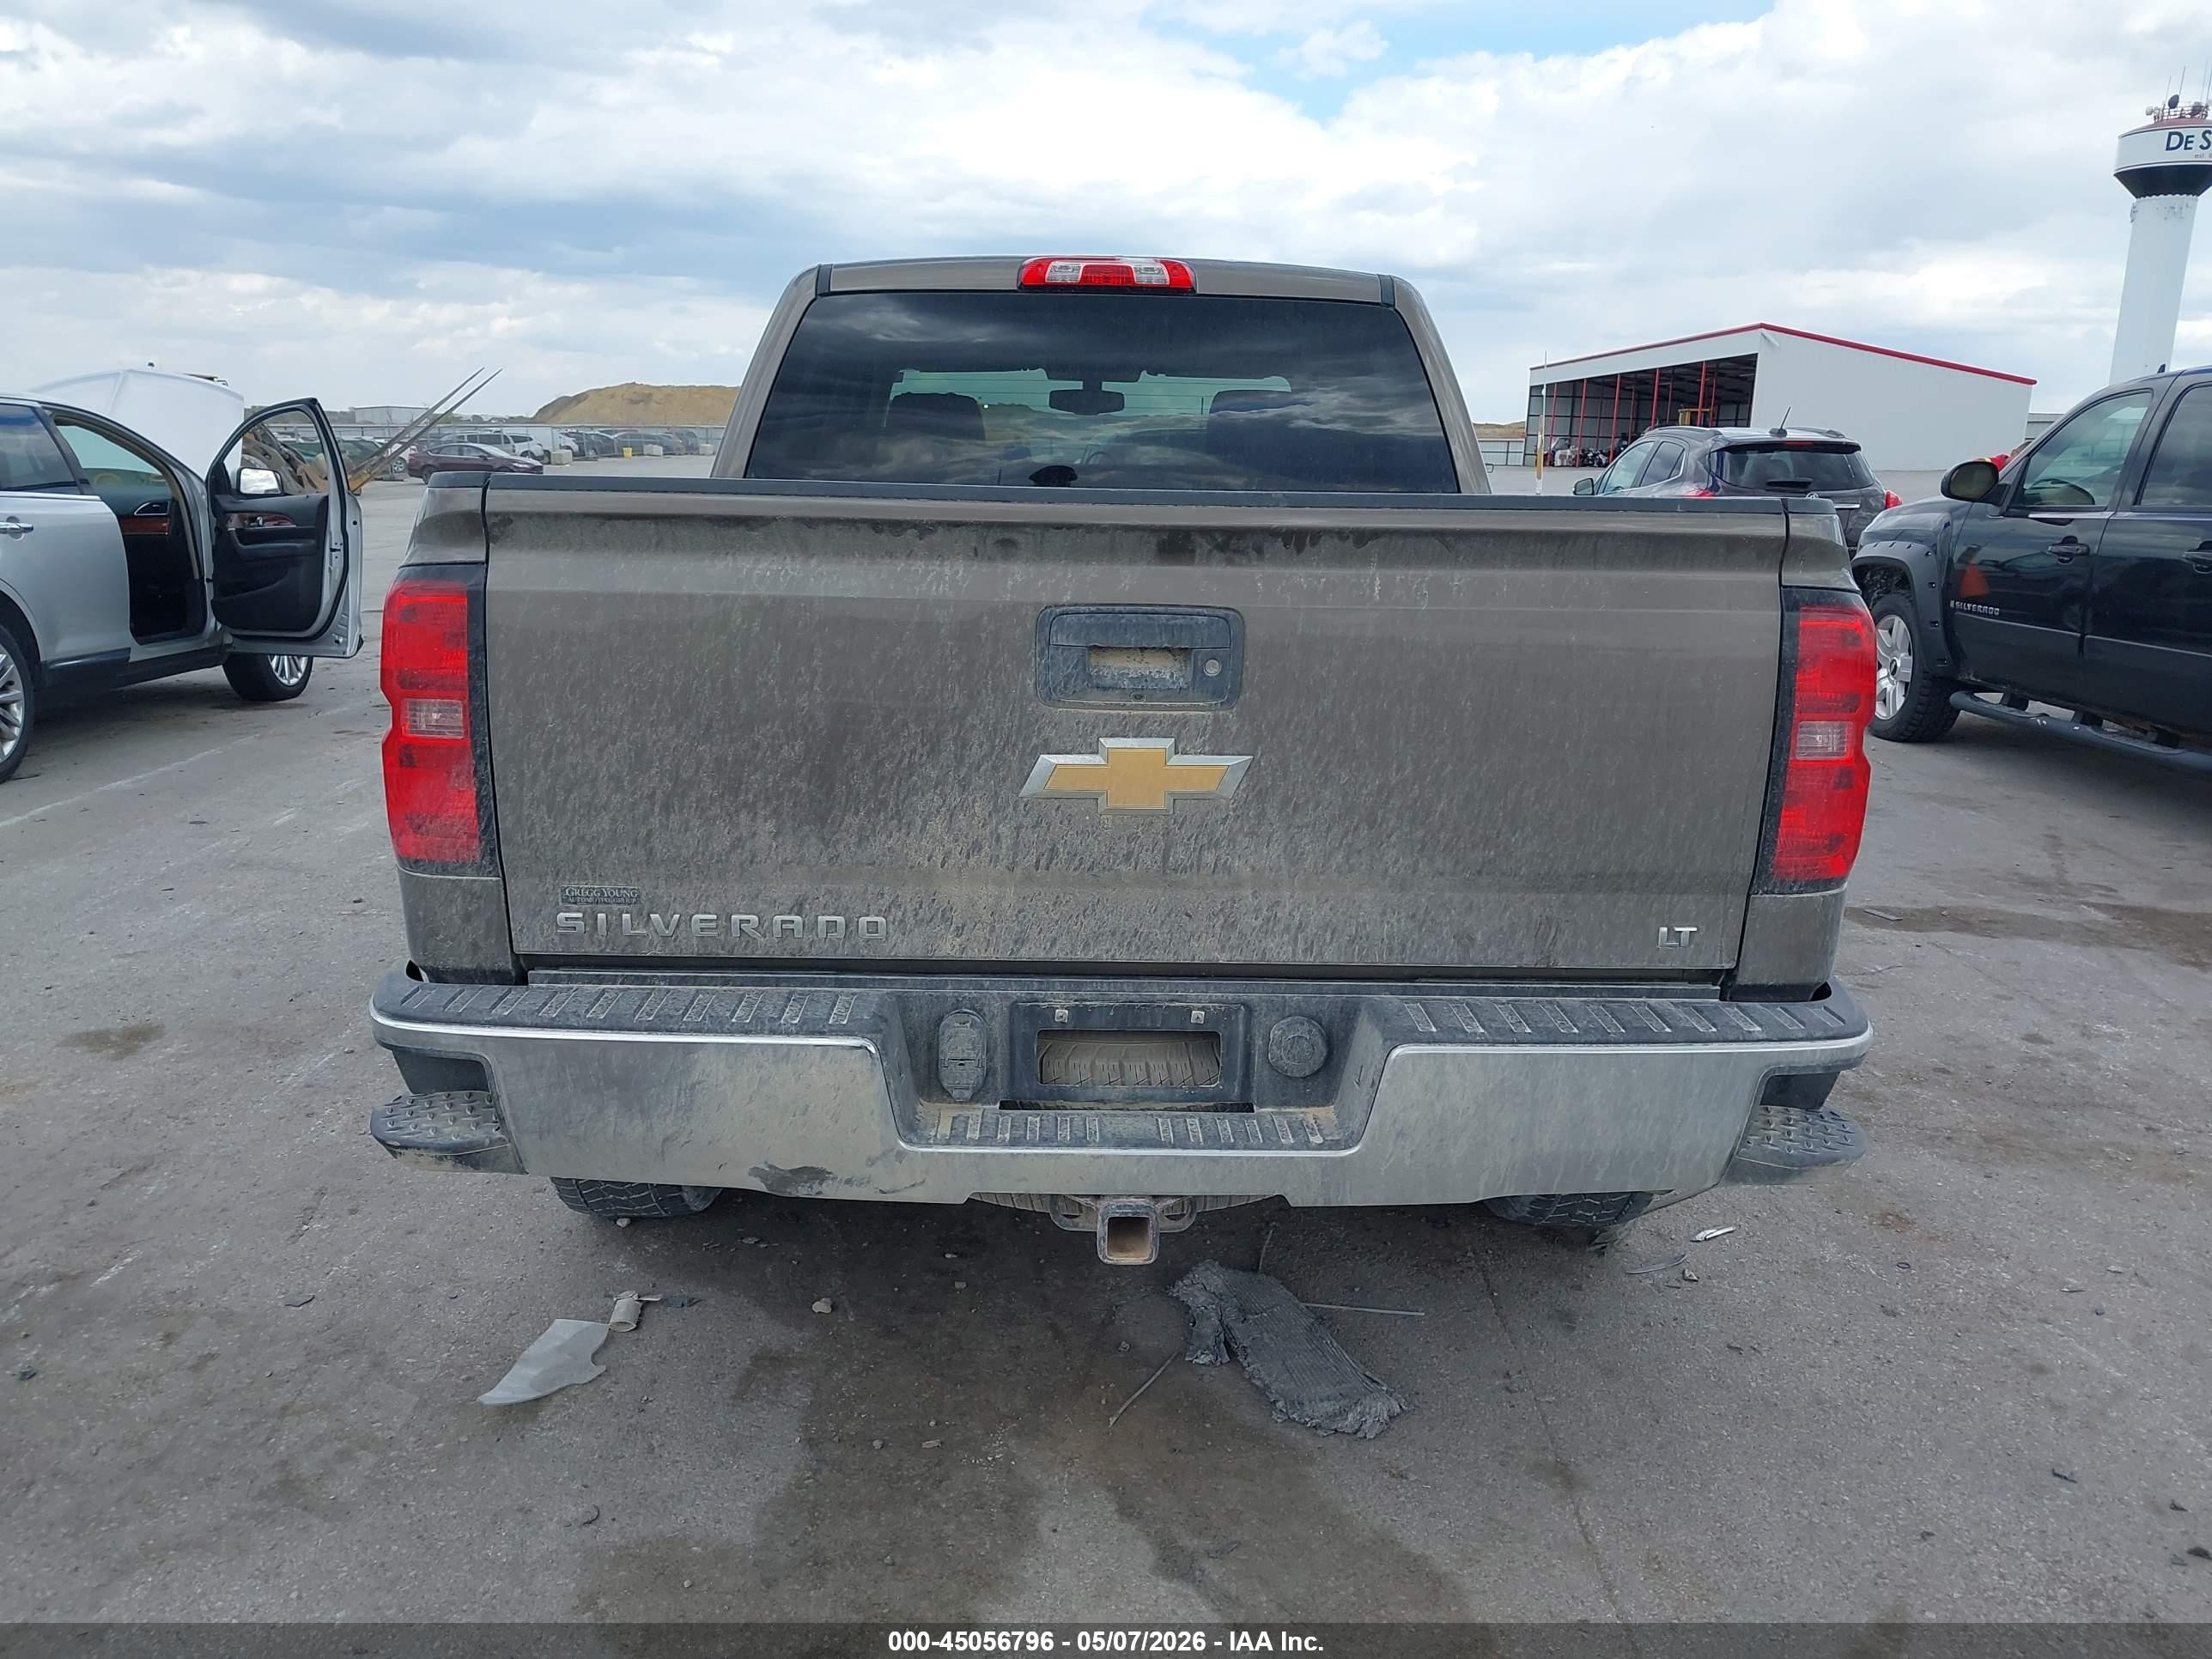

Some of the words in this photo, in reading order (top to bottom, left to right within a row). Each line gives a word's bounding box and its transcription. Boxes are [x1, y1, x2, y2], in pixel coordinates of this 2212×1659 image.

[1955, 601, 2000, 616] SILVERADO
[565, 886, 601, 896] GREGG
[602, 888, 638, 898] YOUNG
[556, 912, 888, 939] SILVERADO
[1658, 927, 1698, 948] LT
